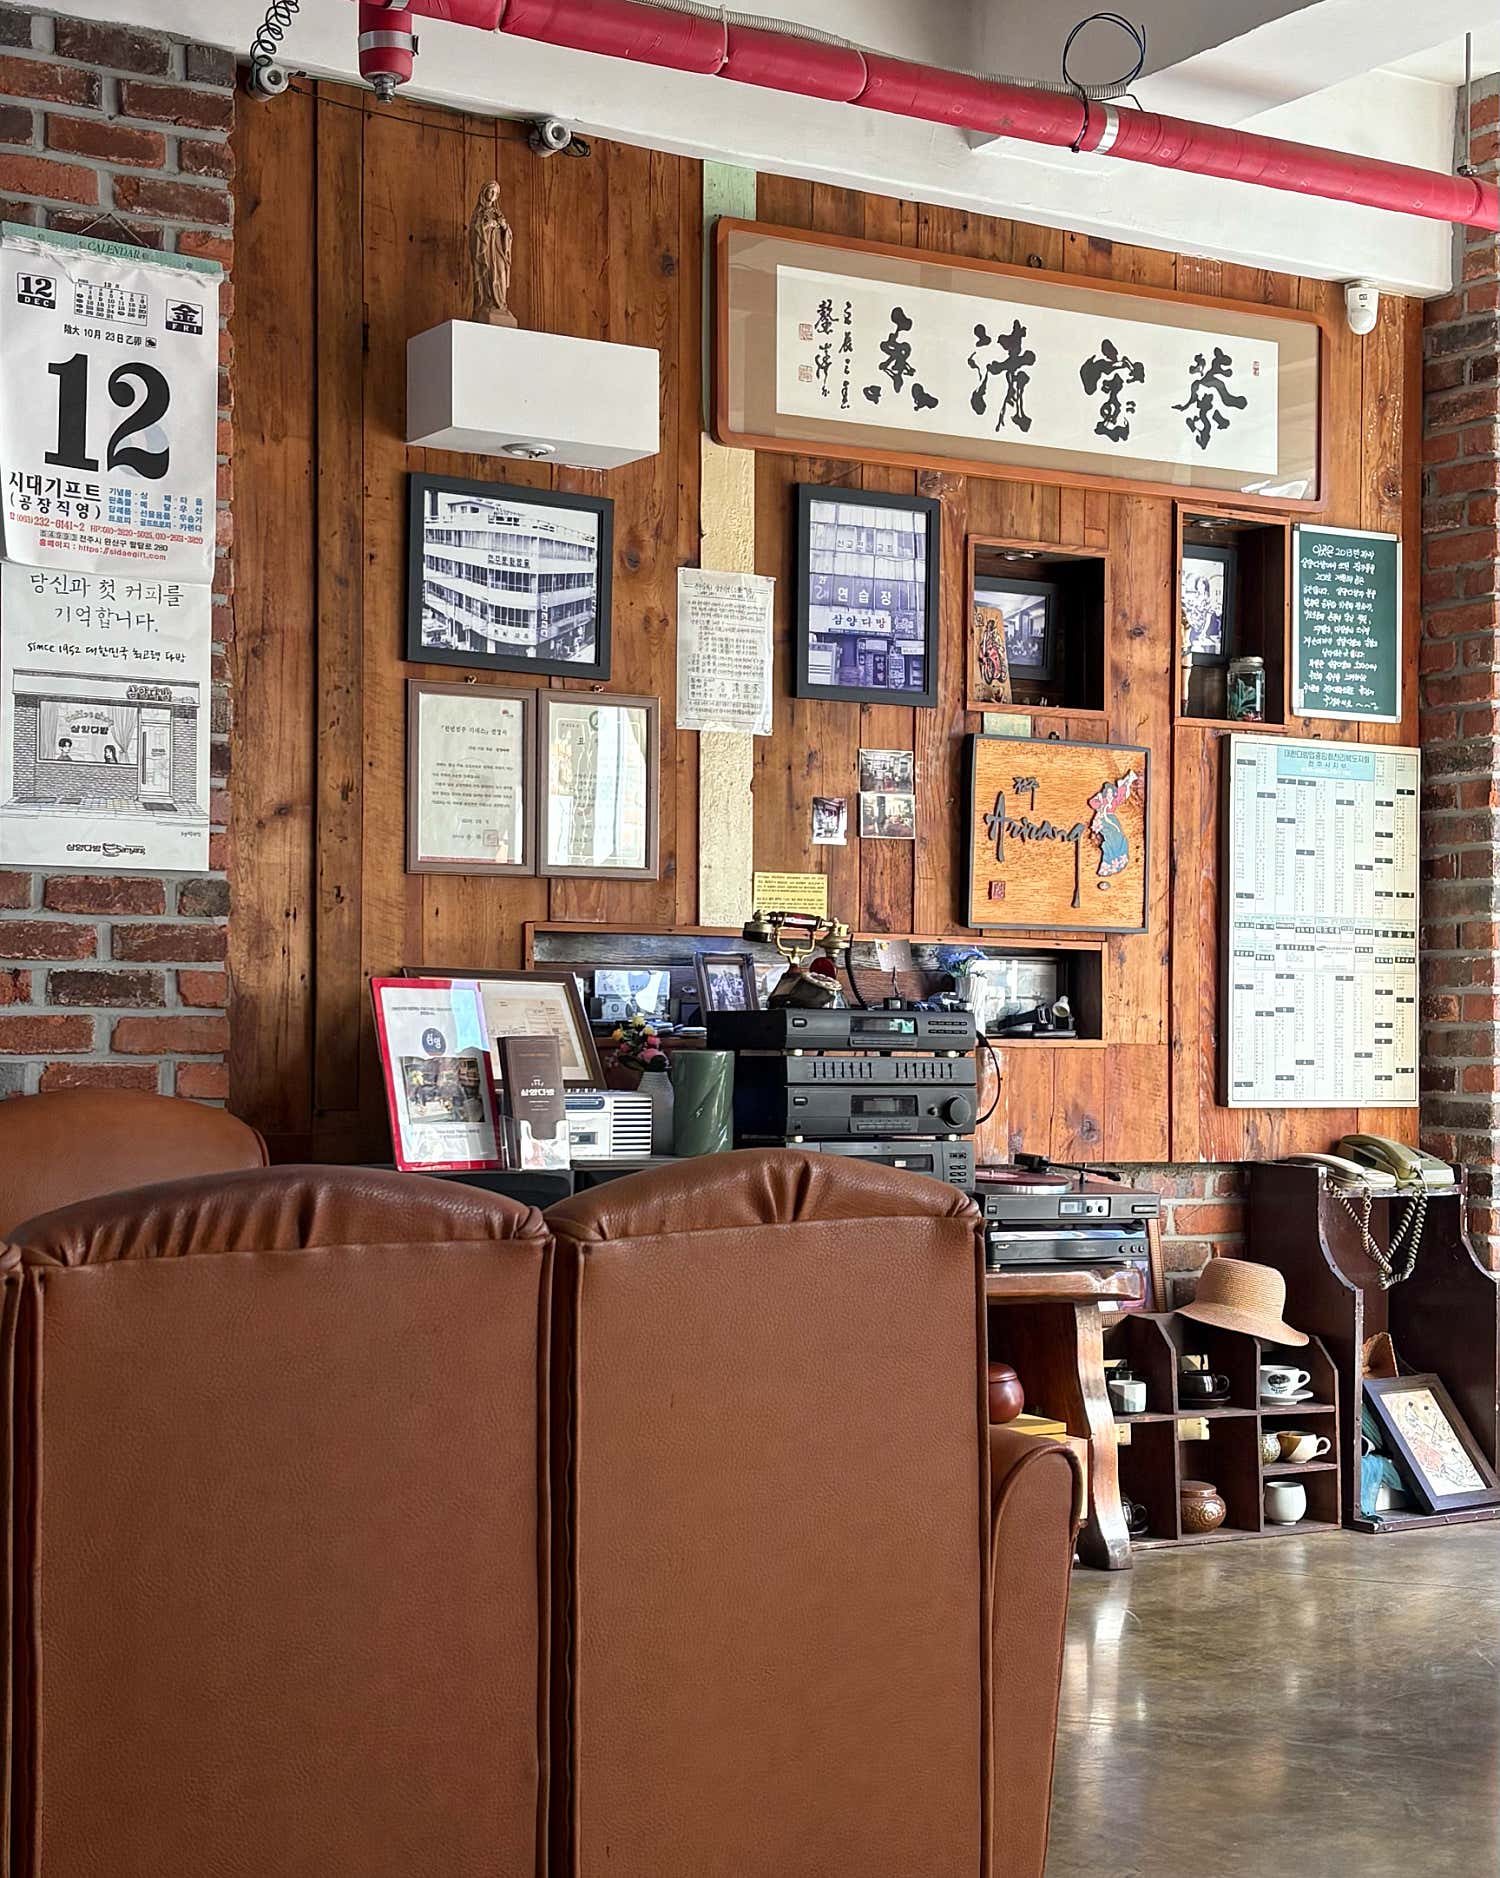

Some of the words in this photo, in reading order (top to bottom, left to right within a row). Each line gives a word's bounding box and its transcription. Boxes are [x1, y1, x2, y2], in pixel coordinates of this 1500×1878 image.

[88, 242, 140, 259] CALENDAR
[21, 276, 53, 297] 12
[24, 297, 49, 306] DEC
[170, 304, 199, 324] 金
[171, 324, 198, 334] FRI
[44, 353, 171, 479] 12
[9, 471, 102, 502] 시대기프트
[10, 492, 101, 520] (공장직영)
[39, 539, 70, 549] 홈페이지
[80, 534, 101, 544] 전주시
[31, 573, 91, 598] 당신과
[99, 579, 116, 601] 첫
[125, 582, 185, 607] 커피를
[837, 586, 892, 606] 연습장
[55, 605, 159, 633] 기억합니다.
[832, 614, 887, 629] 삼양다방
[58, 644, 83, 656] 1952
[85, 646, 129, 660] 대한민국
[984, 790, 1086, 908] Arirang
